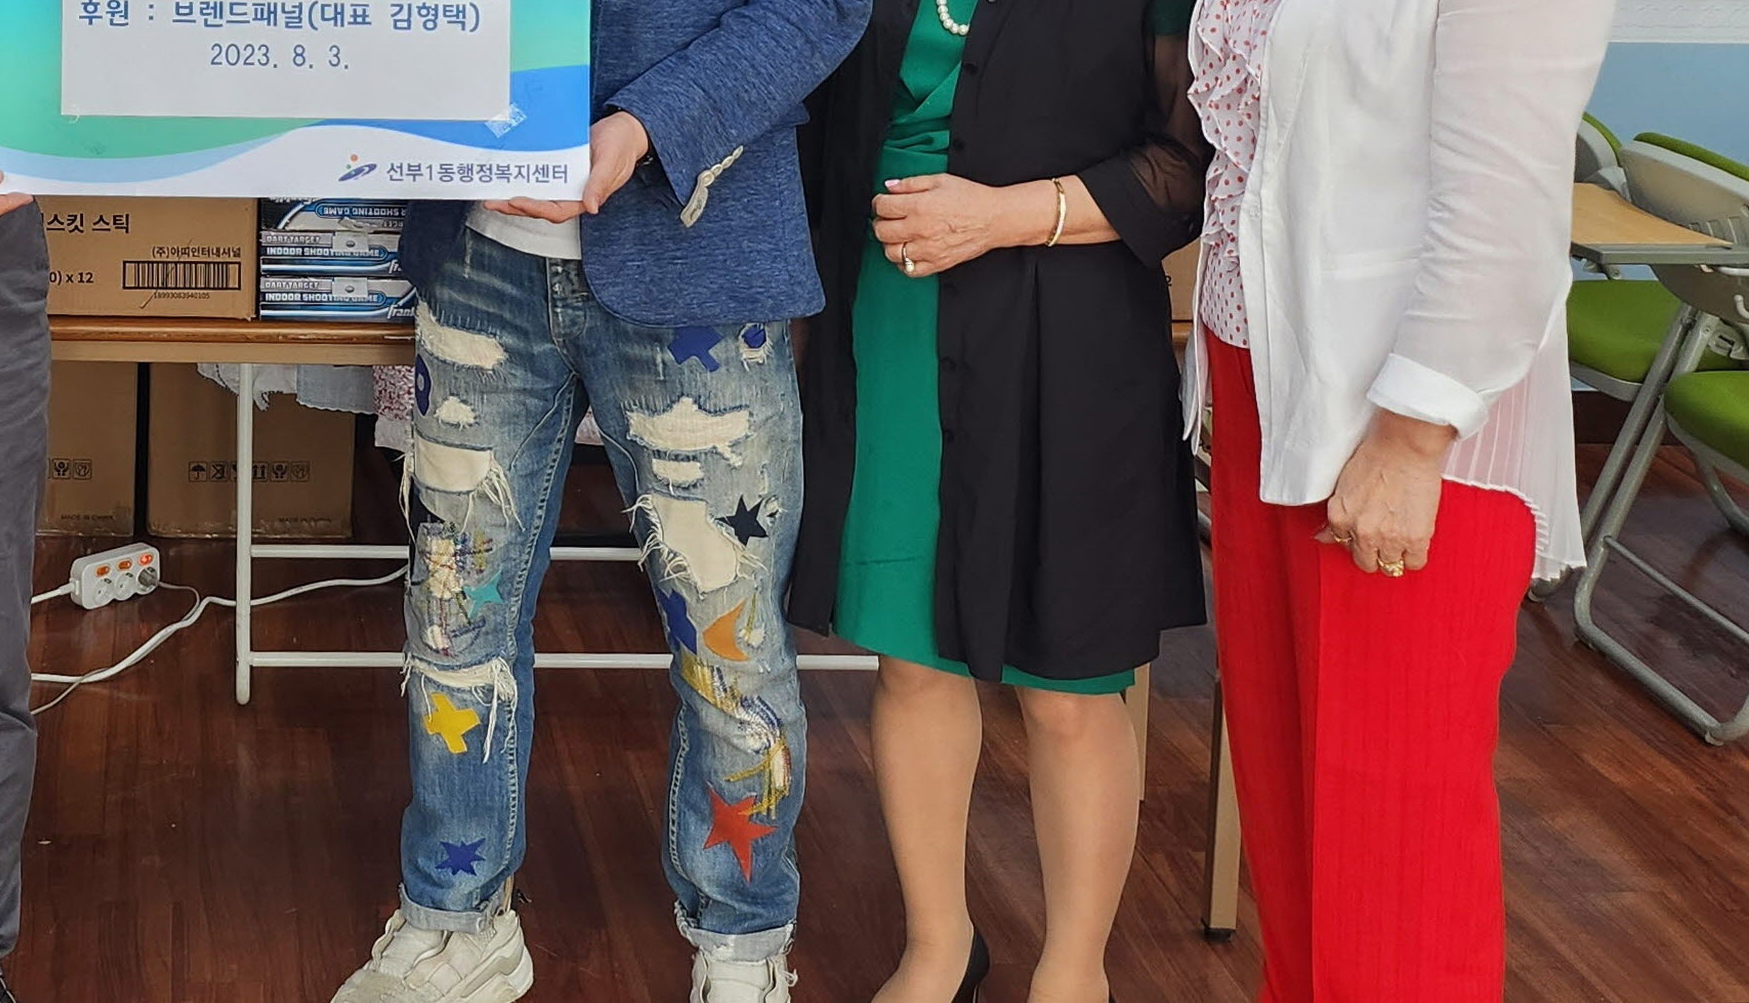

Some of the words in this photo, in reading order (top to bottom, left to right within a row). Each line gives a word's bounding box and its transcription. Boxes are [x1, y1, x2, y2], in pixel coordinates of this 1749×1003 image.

[172, 0, 372, 32] 브렌드패널(대표
[390, 0, 481, 33] 김형택)
[210, 43, 278, 69] 2023.
[293, 44, 314, 69] 8.
[328, 45, 350, 71] 3.
[386, 162, 569, 184] 선부1동행정복지센터
[323, 207, 350, 215] GAME
[352, 207, 399, 216] SHOOTING
[91, 213, 130, 234] 스틱
[267, 247, 302, 256] INDOOR
[49, 271, 62, 285] 0)
[78, 272, 94, 284] 12
[266, 293, 301, 302] INDOOR
